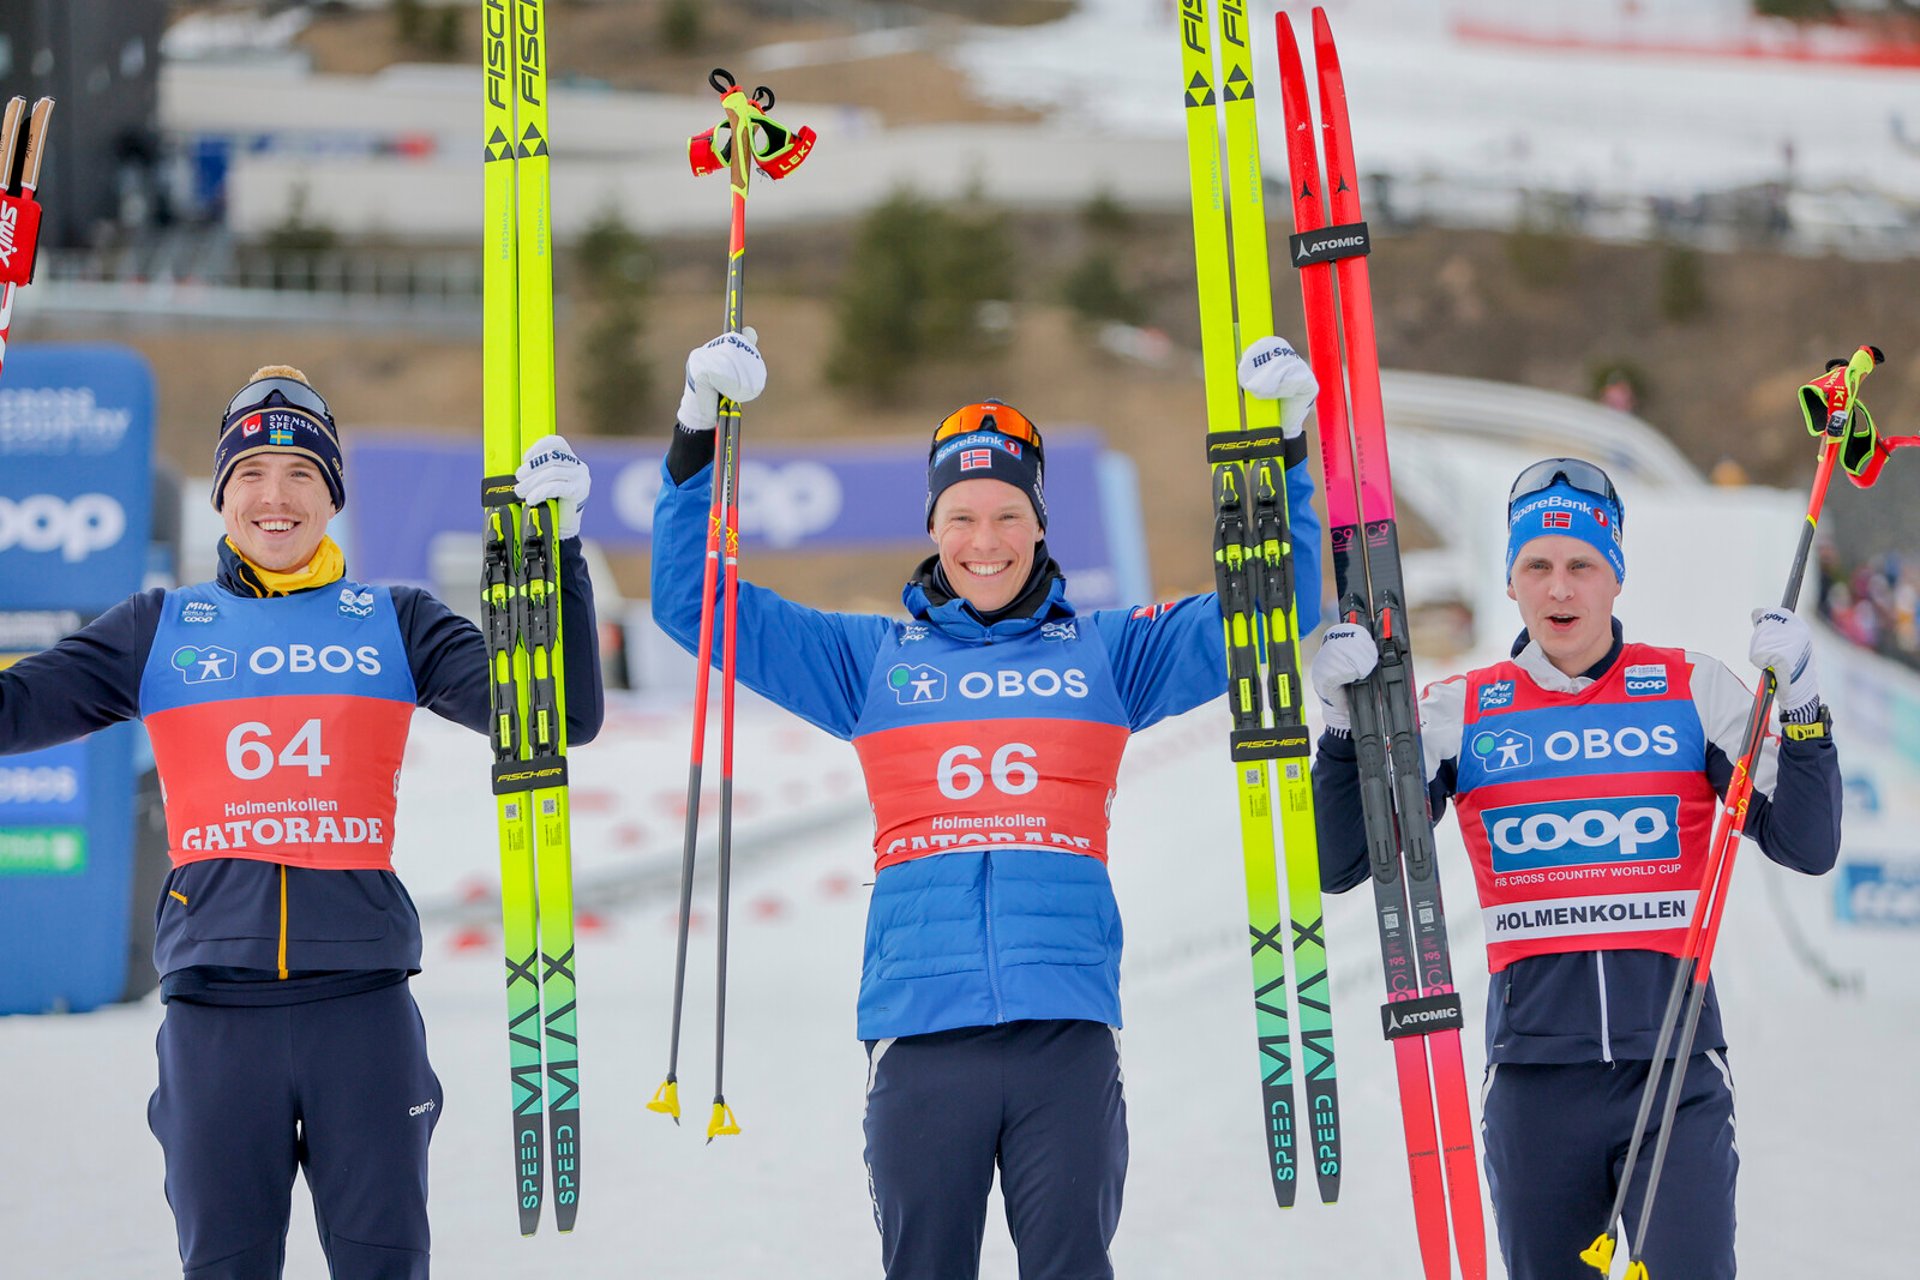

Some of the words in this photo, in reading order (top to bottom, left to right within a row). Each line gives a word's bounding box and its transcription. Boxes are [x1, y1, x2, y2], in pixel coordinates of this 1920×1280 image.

[1222, 0, 1244, 48] FI
[487, 0, 506, 110] FISC
[520, 0, 540, 107] FISC
[779, 140, 812, 171] LEKI
[1310, 235, 1365, 253] ATOMIC
[269, 414, 319, 436] SVENSKA
[269, 421, 296, 432] SPEL
[937, 434, 1002, 460] SpareBank
[1209, 437, 1281, 452] FISCHER
[1512, 496, 1592, 526] SpareBank
[1366, 522, 1389, 539] C9
[250, 644, 382, 675] OBOS
[959, 668, 1089, 699] OBOS
[1627, 680, 1666, 690] coop
[226, 718, 330, 780] 64
[1236, 738, 1307, 749] FISCHER
[1544, 725, 1678, 761] OBOS
[496, 768, 563, 782] FISCHER
[937, 742, 1039, 800] 66
[225, 798, 338, 817] Holmenkollen
[932, 814, 1046, 830] Holmenkollen
[182, 816, 384, 850] GATORADE
[1493, 807, 1670, 855] coop
[1495, 877, 1507, 887] FIS
[1509, 873, 1545, 886] CROSS
[1548, 868, 1606, 882] COUNTRY
[1610, 864, 1656, 878] WORLD
[1659, 863, 1682, 875] CUP
[1496, 899, 1686, 931] HOLMENKOLLEN
[1248, 921, 1292, 1087] MAX
[1290, 915, 1336, 1080] MAX
[541, 943, 579, 1112] MAX
[1401, 1007, 1458, 1025] ATOMIC
[505, 947, 542, 1117] MAX
[1271, 1100, 1294, 1181] SPEED
[1315, 1094, 1338, 1176] SPEED
[521, 1129, 538, 1209] SPEED
[557, 1124, 574, 1205] SPEED
